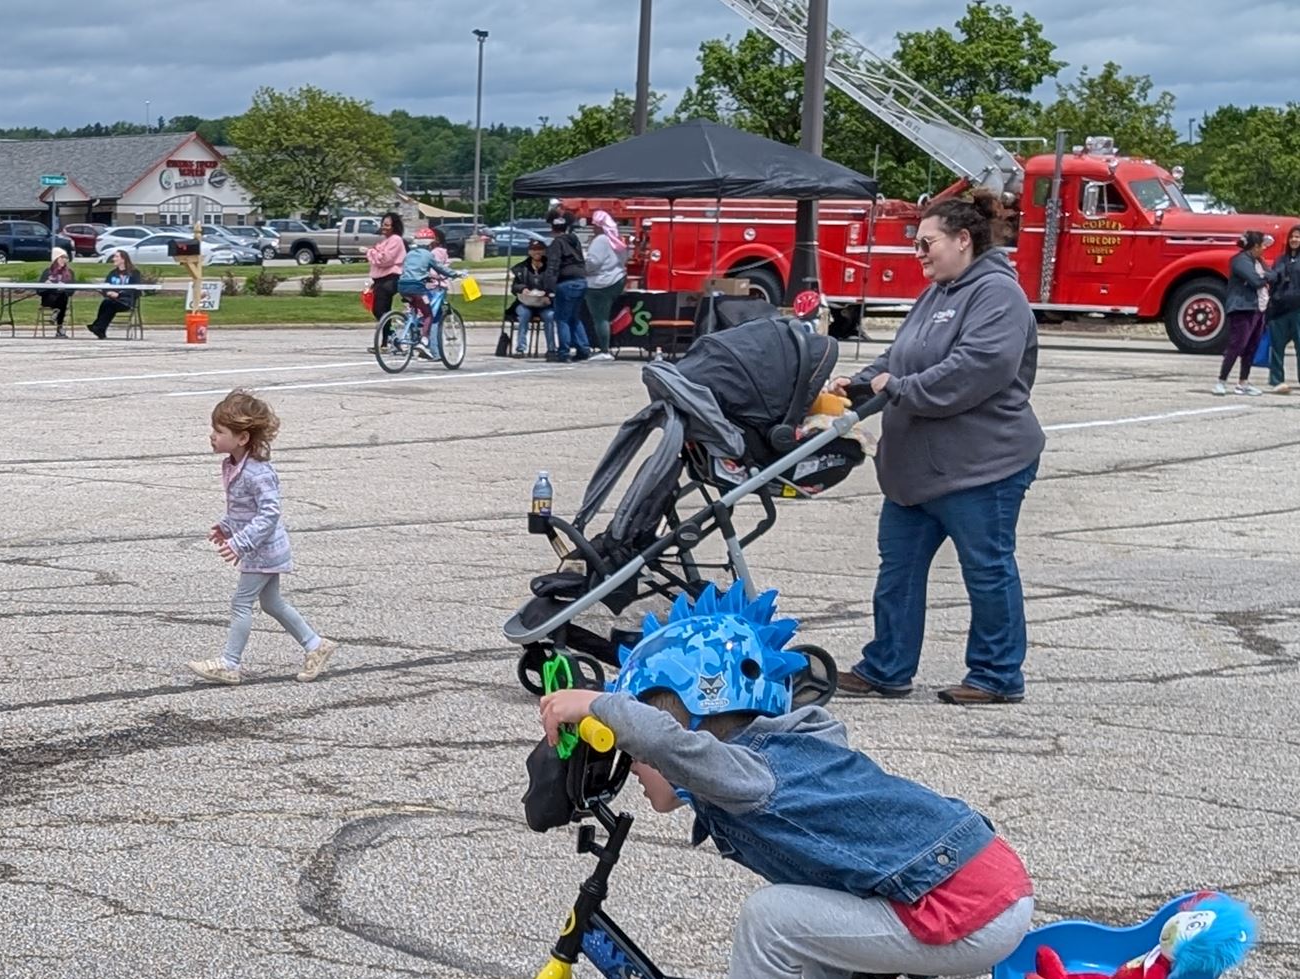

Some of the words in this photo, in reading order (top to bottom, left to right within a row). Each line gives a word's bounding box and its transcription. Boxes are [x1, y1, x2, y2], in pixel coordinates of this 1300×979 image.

[1082, 219, 1123, 231] COPLEY
[1081, 236, 1100, 246] FIRE
[1101, 236, 1121, 246] DEPT
[189, 300, 215, 309] OEN
